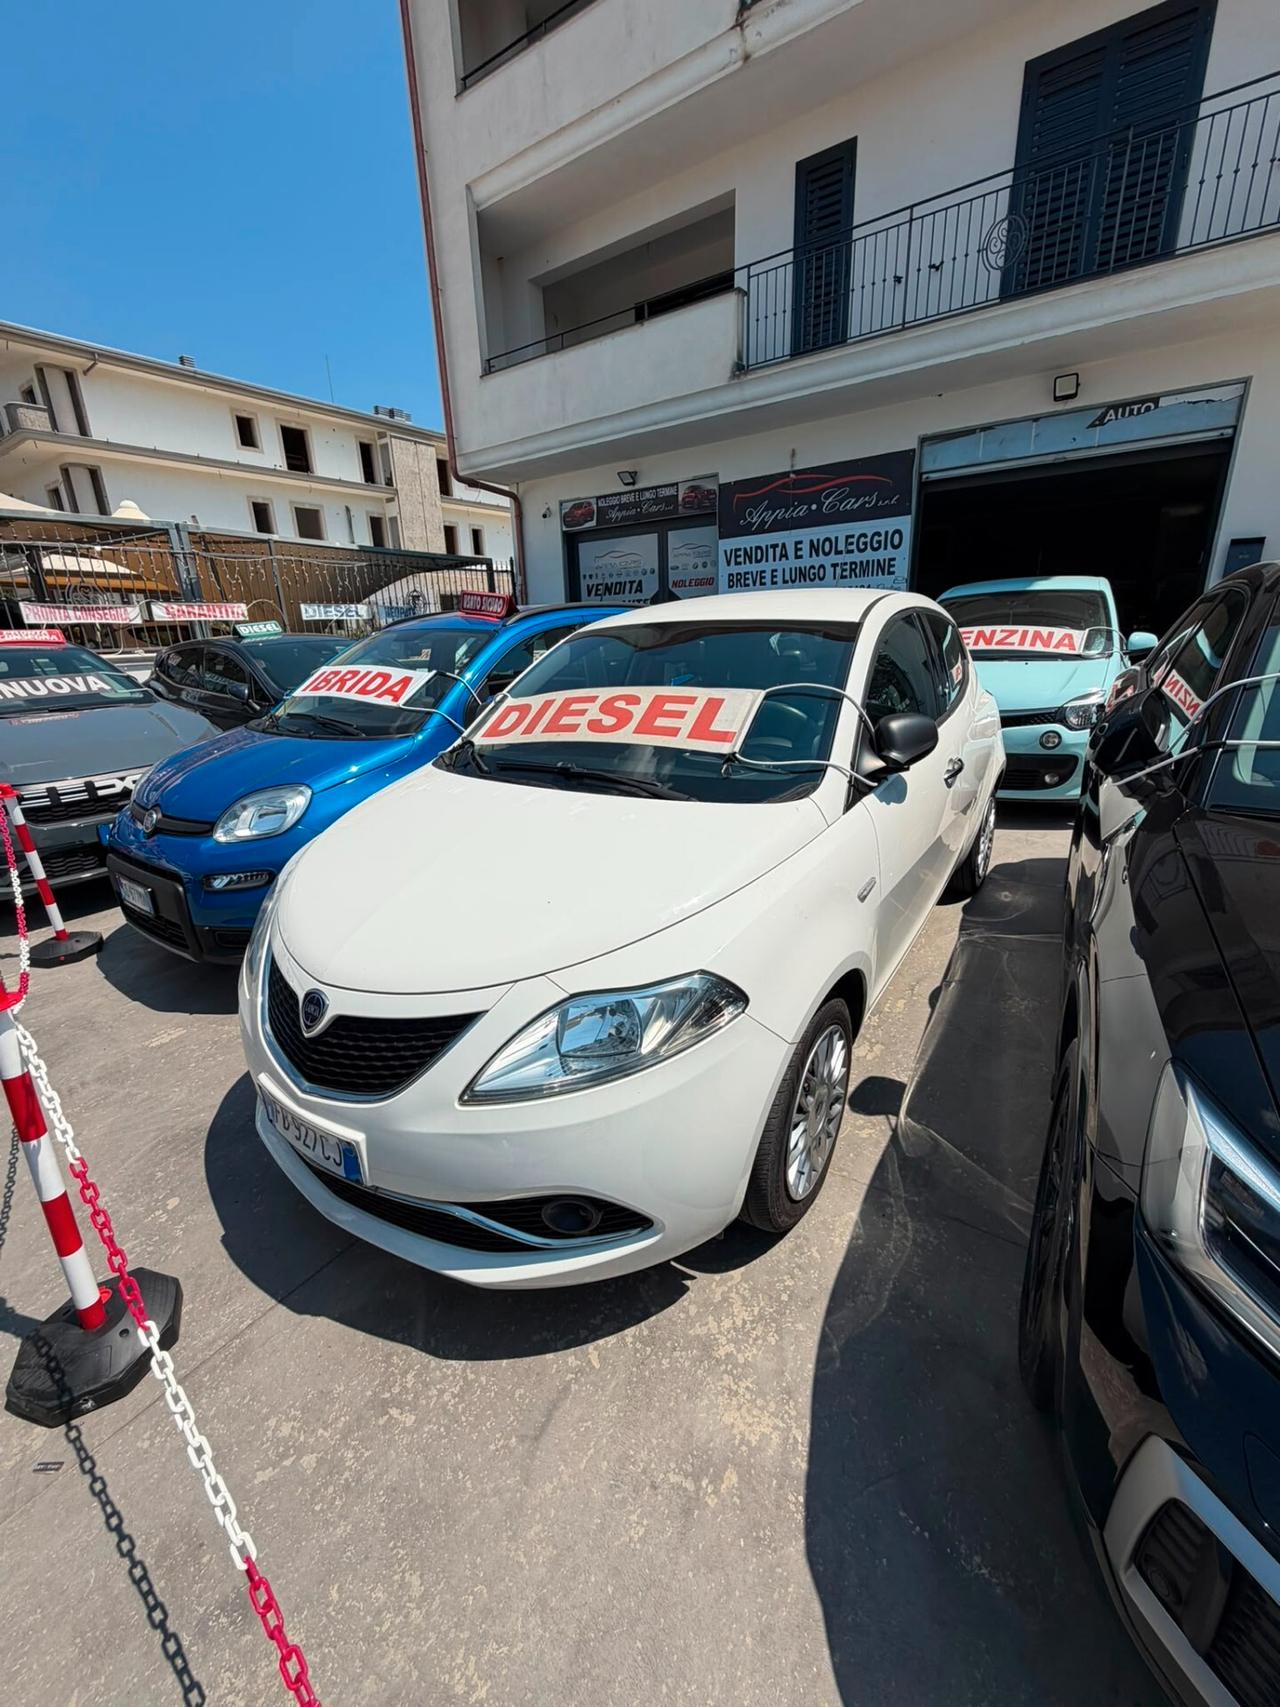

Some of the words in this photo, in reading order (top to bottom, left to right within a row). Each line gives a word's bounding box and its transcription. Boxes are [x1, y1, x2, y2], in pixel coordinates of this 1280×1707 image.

[620, 492, 635, 504] BREVE
[640, 489, 657, 501] LUNGO
[656, 485, 678, 498] TERMINE
[739, 499, 810, 532] Appia
[820, 486, 878, 514] Cars
[724, 541, 790, 568] VENDITA
[793, 540, 804, 560] E
[808, 528, 904, 559] NOLEGGIO
[671, 576, 716, 589] NOLEGGIO
[727, 570, 767, 590] BREVE
[770, 568, 779, 586] E
[782, 564, 827, 585] LUNGO
[830, 557, 897, 581] TERMINE
[586, 579, 644, 598] VENDITA
[304, 603, 364, 619] DIESEL
[239, 622, 281, 634] DIESEL
[961, 629, 1078, 652] ENZINA
[0, 675, 111, 699] NUOVA
[301, 670, 414, 703] IBRIDA
[481, 693, 737, 743] DIESEL
